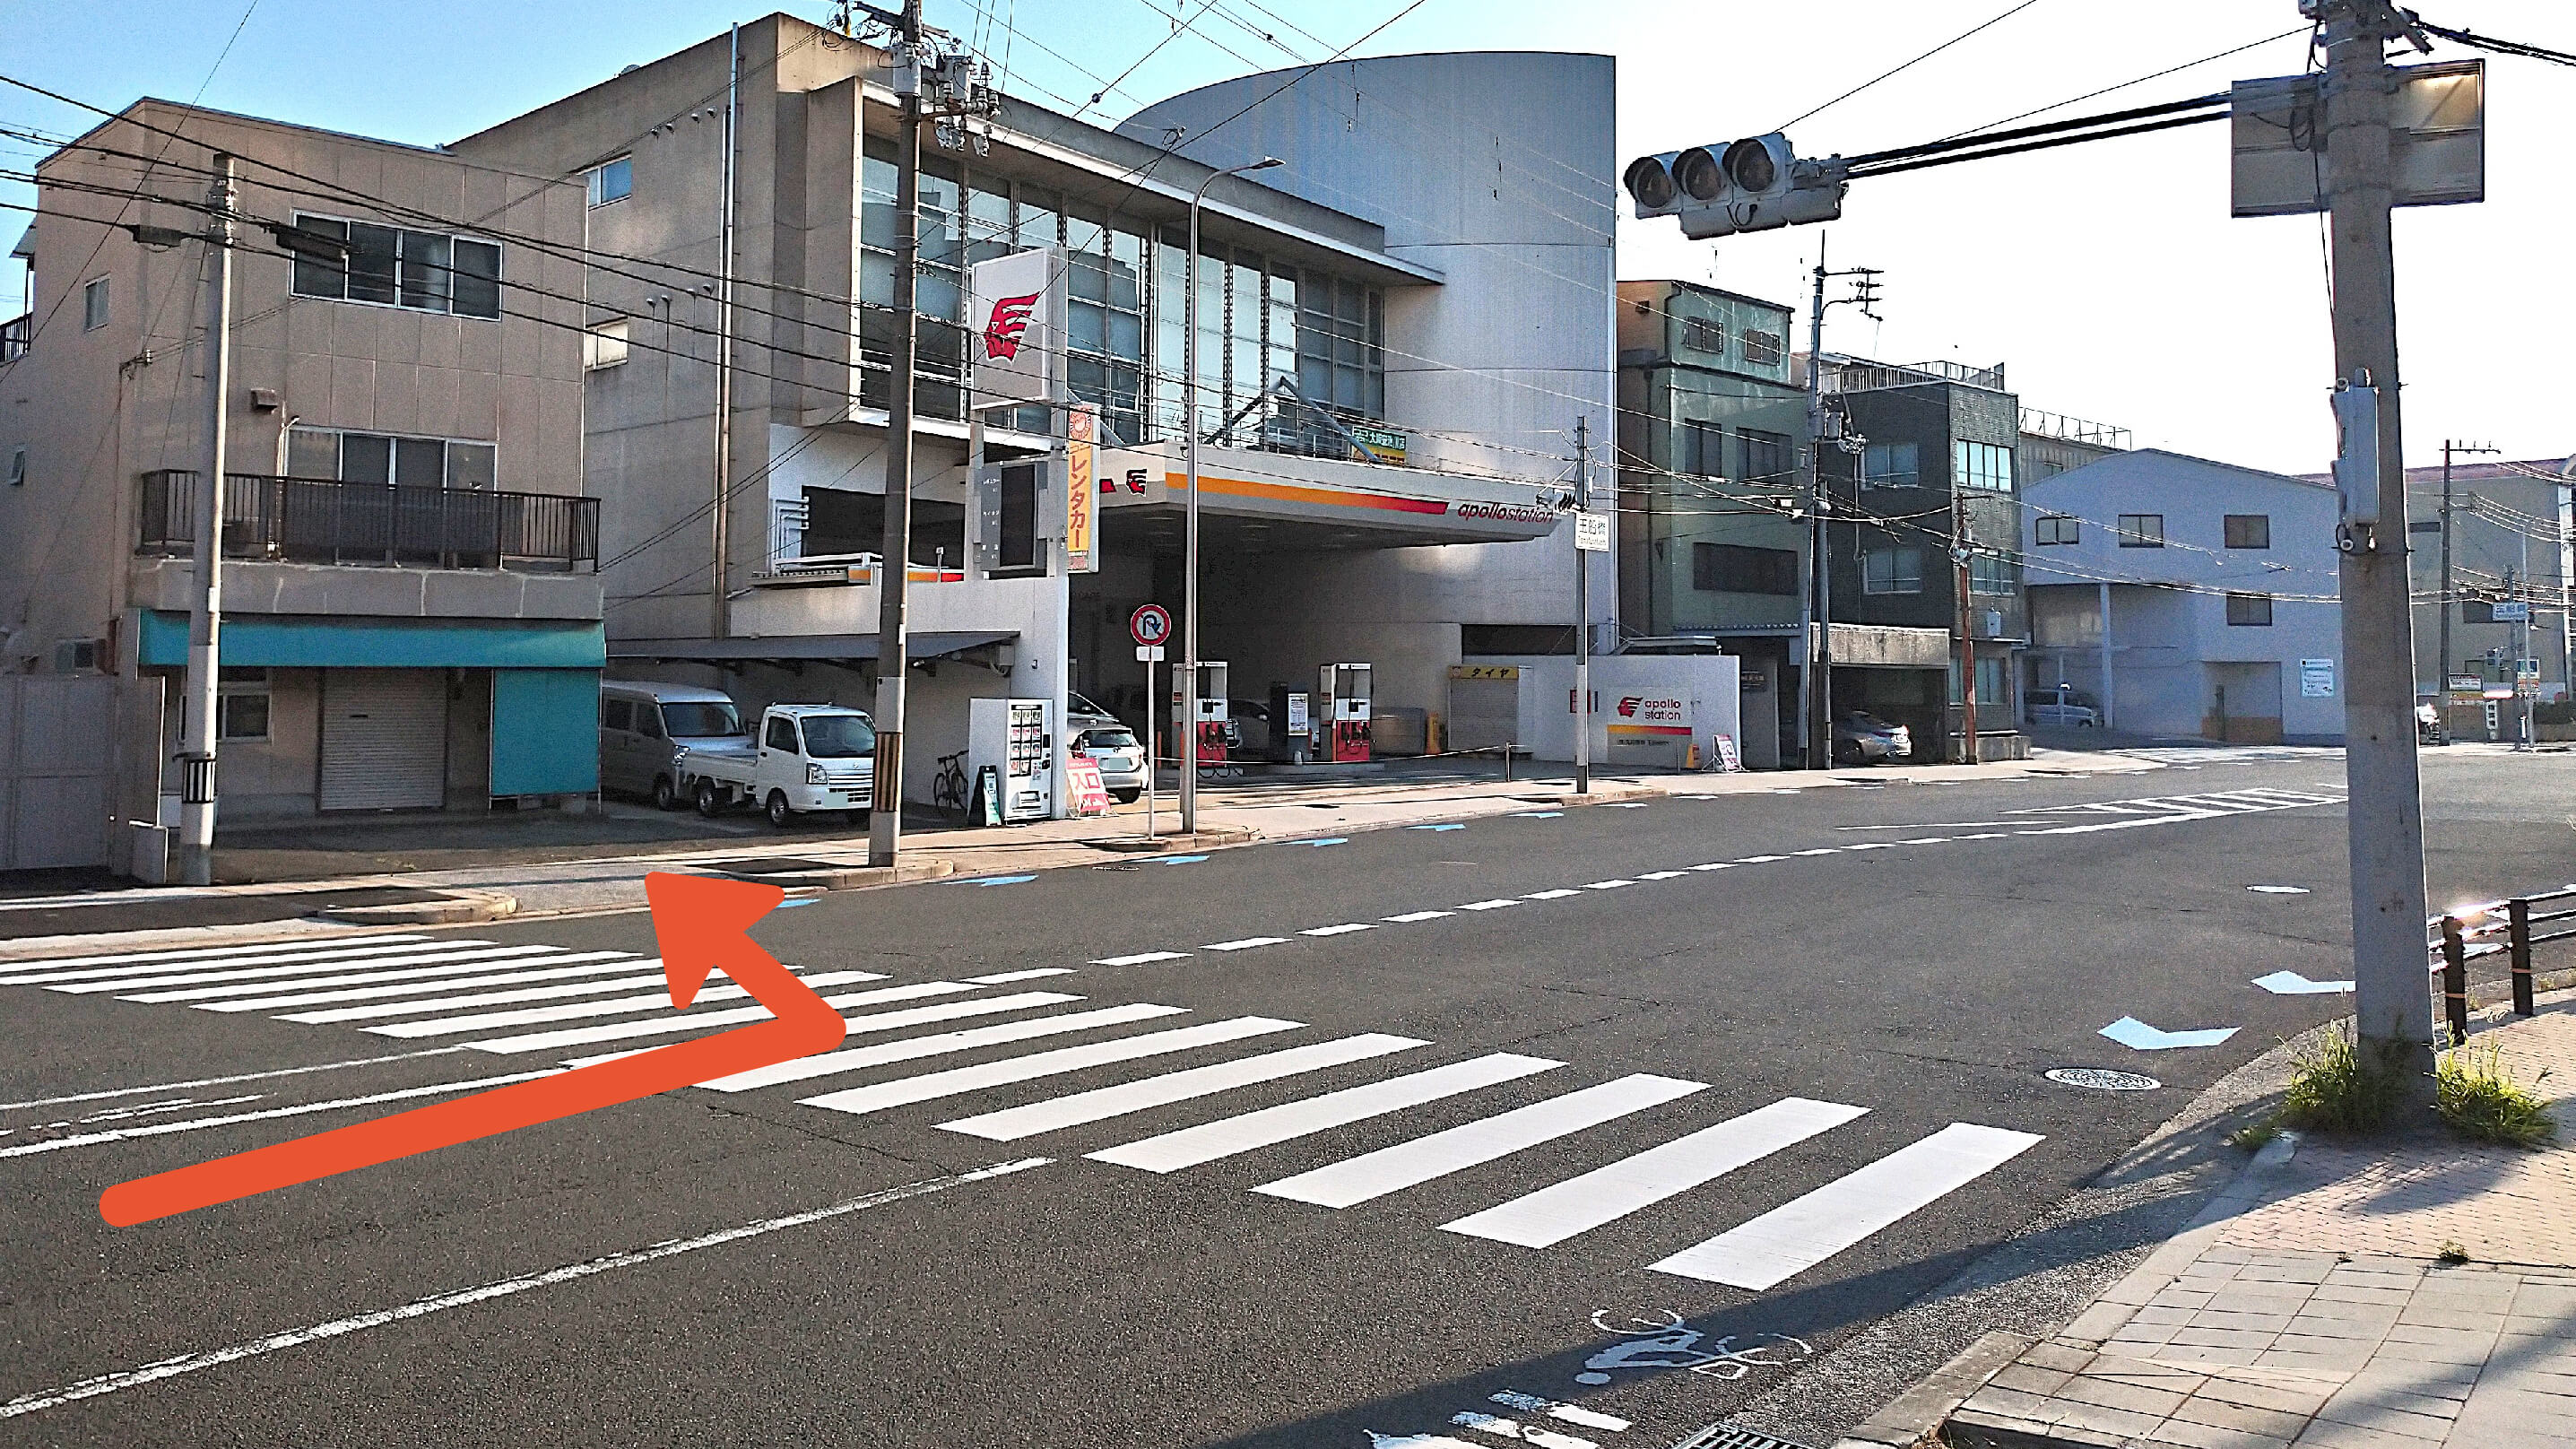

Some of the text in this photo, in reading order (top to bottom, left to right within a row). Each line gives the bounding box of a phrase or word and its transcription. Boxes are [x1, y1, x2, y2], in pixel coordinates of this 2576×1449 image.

[1071, 455, 1088, 549] レンタカー
[1457, 502, 1554, 524] apollostation
[1470, 667, 1510, 678] タイヤ
[1644, 698, 1681, 711] apollo
[1644, 709, 1681, 720] station
[1071, 772, 1101, 790] 入口
